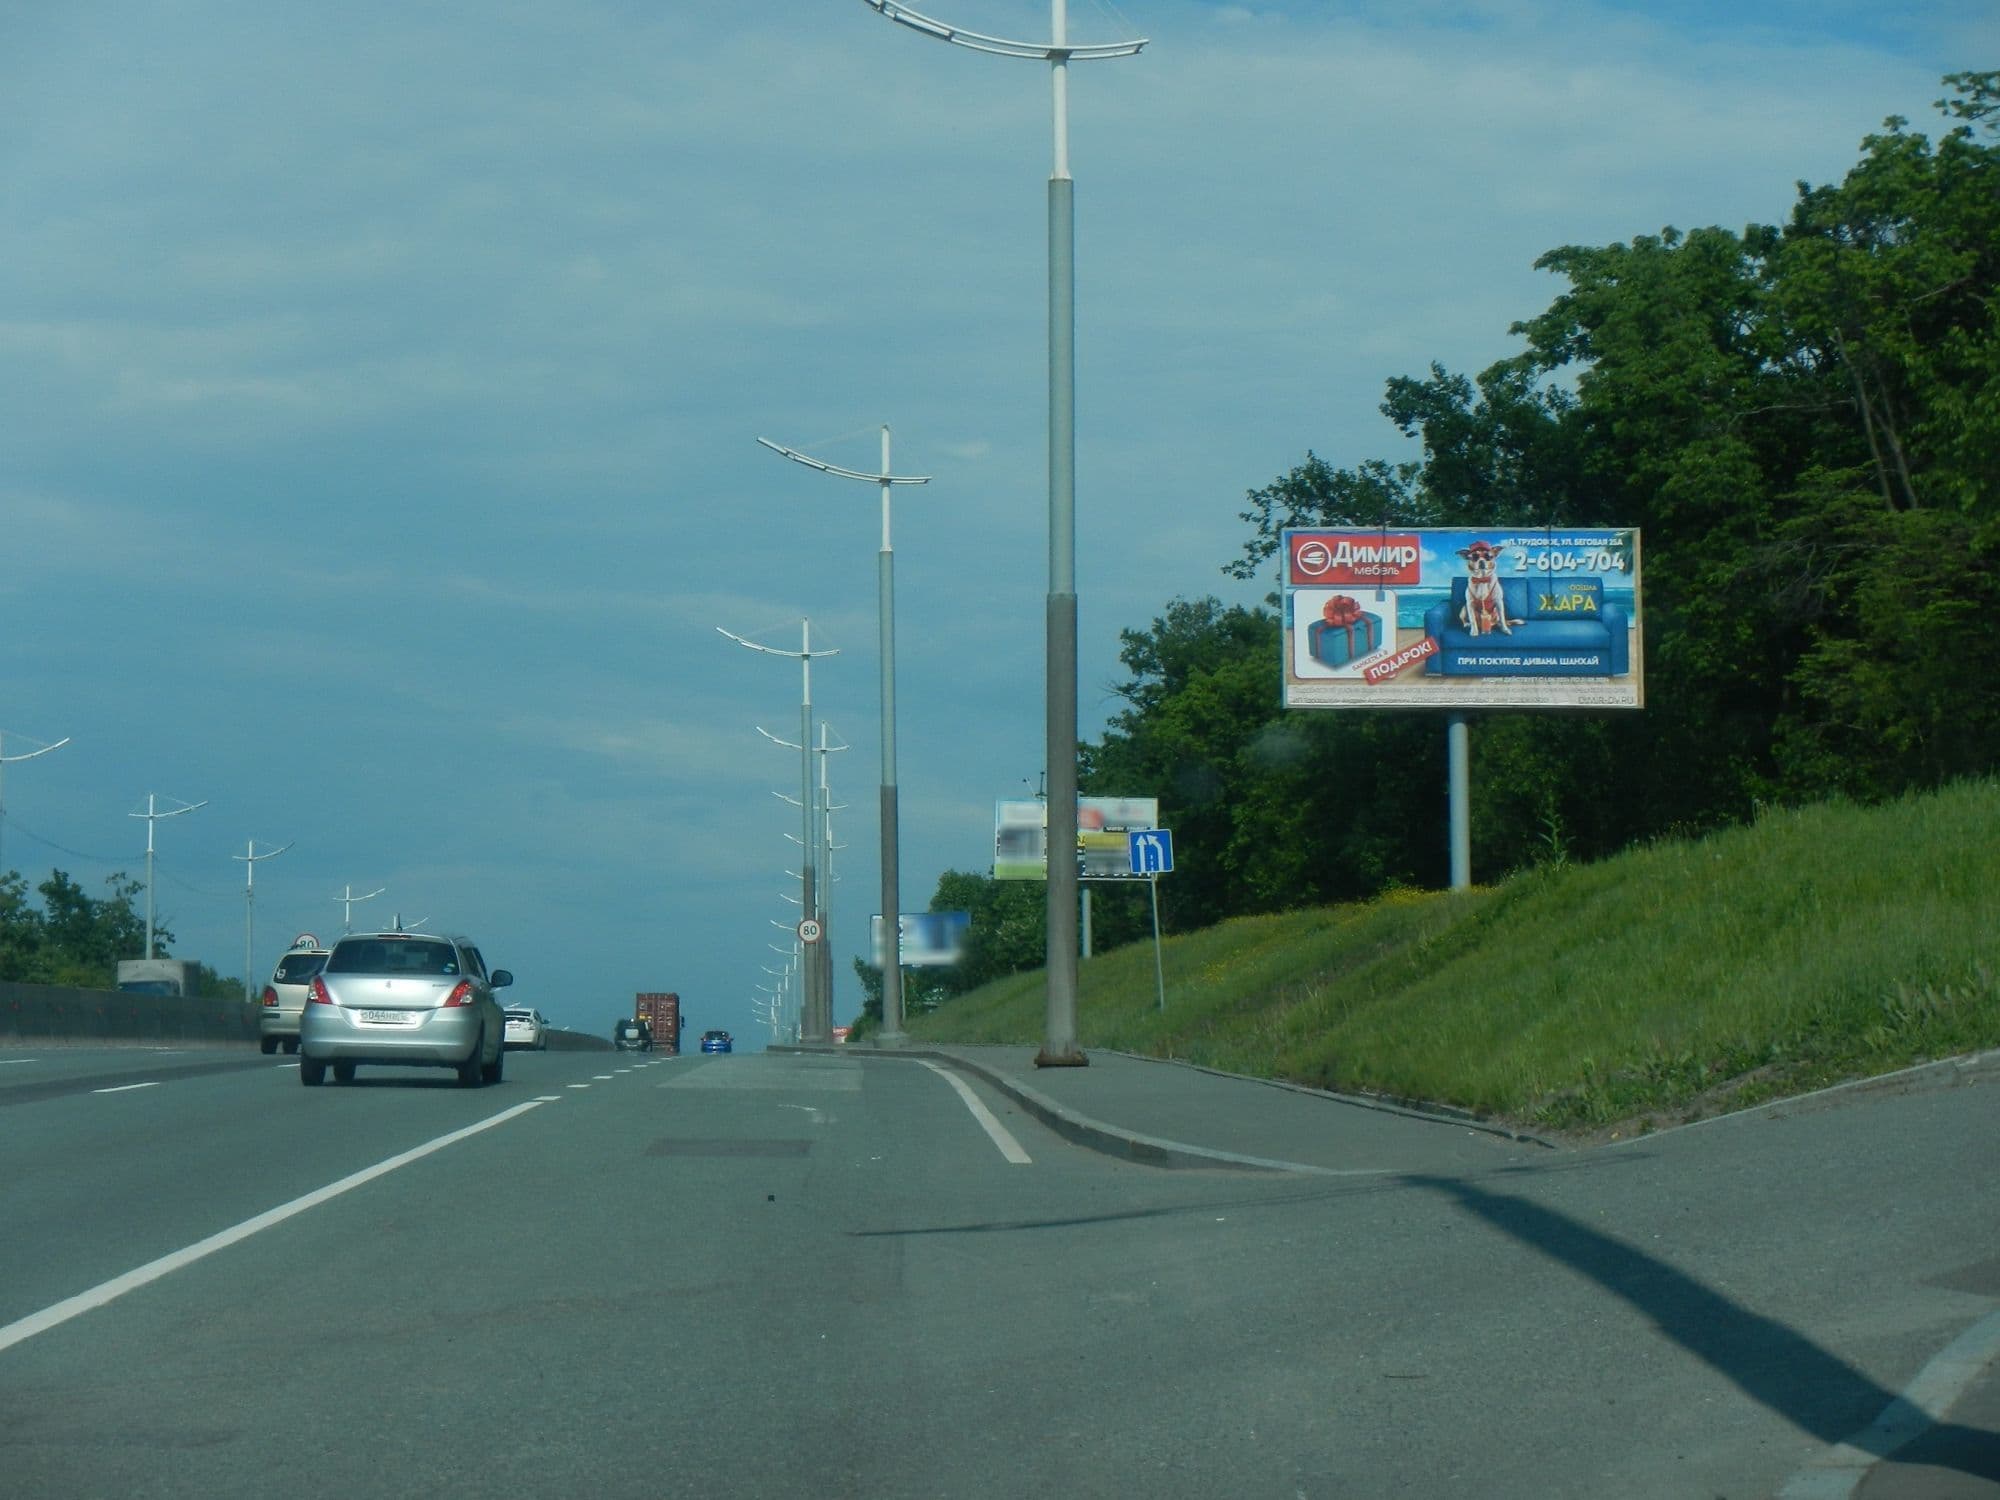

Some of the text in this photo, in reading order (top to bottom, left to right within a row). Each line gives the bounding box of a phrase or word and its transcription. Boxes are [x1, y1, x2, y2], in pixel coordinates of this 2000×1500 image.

[1332, 541, 1417, 568] Димир
[1514, 551, 1625, 571] 2-604-704
[1354, 564, 1400, 576] мебель
[1370, 641, 1432, 679] ПОДАРОК!
[1458, 656, 1599, 667] ПРИ ПОКУПКЕ ДИВАНА ШАНХАЙ
[803, 925, 817, 935] 80
